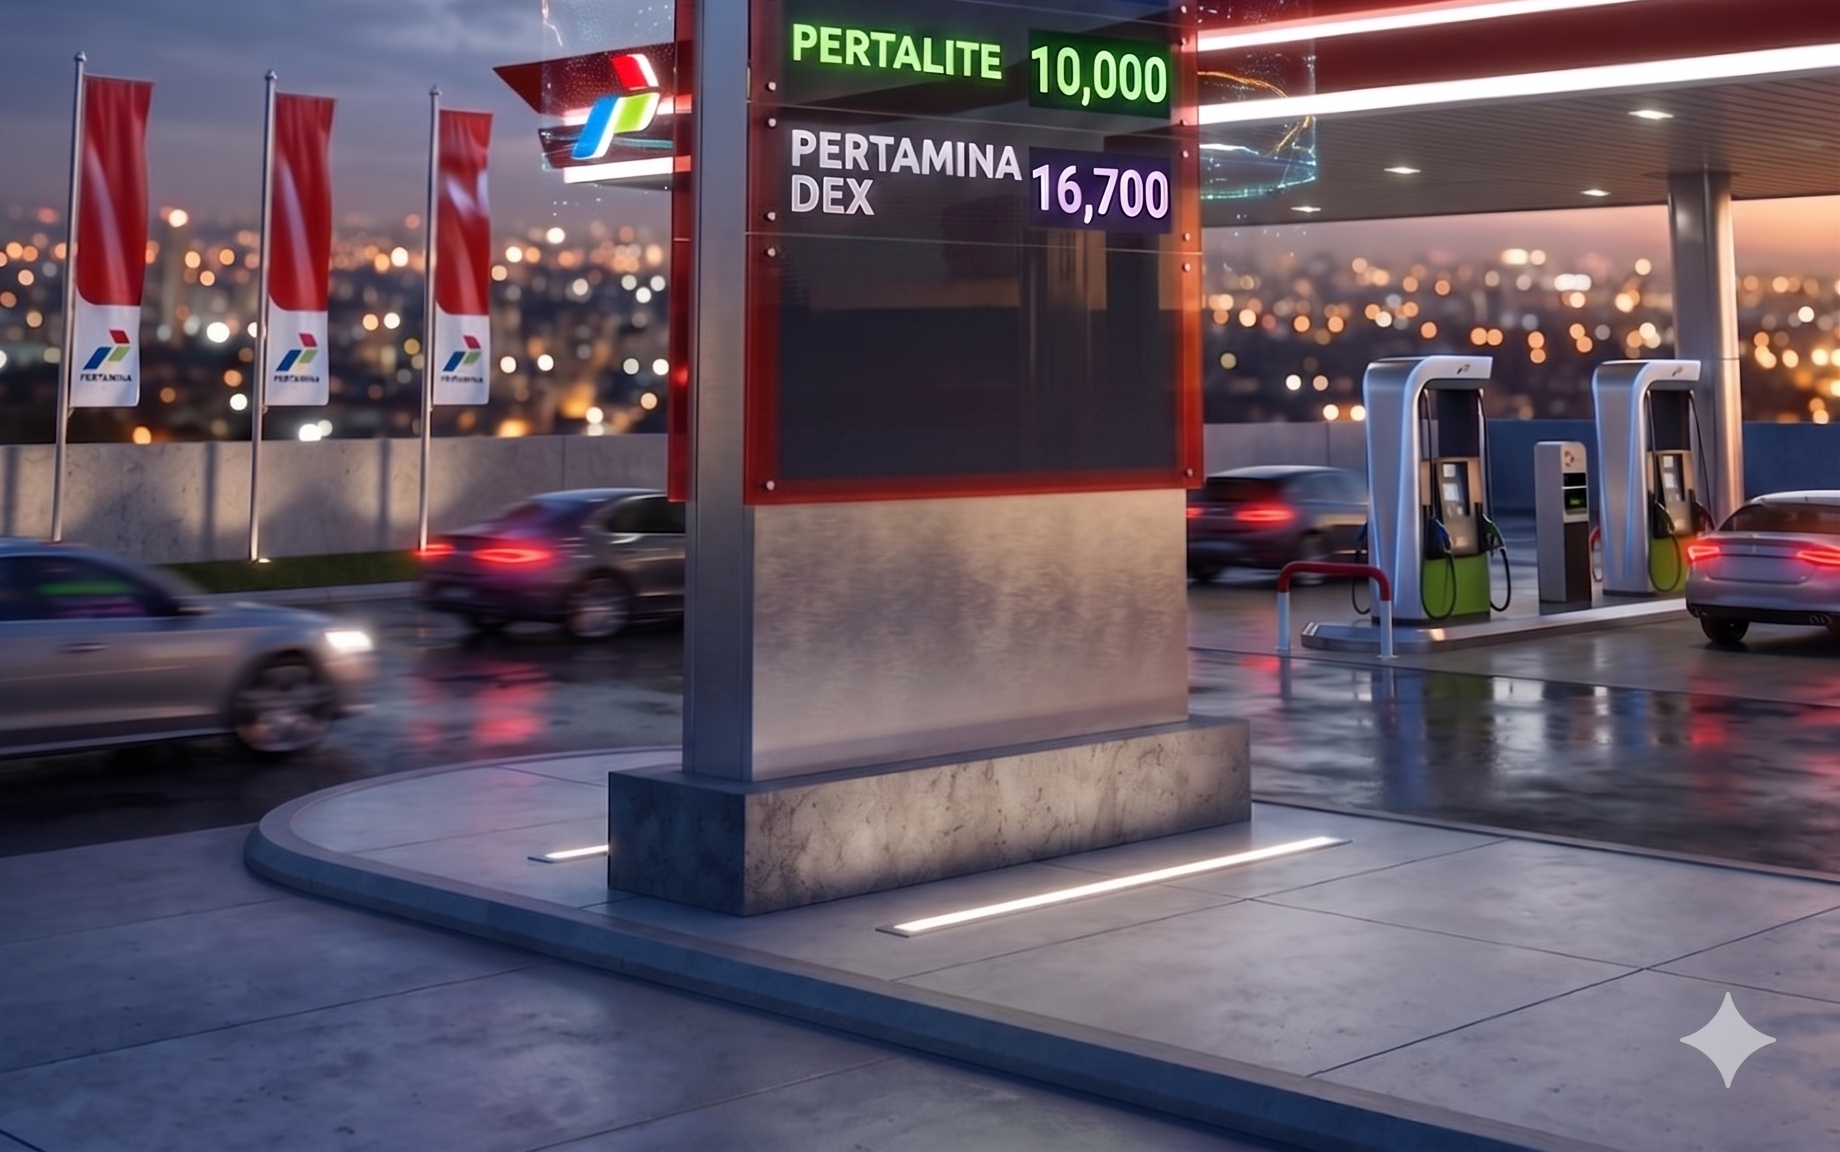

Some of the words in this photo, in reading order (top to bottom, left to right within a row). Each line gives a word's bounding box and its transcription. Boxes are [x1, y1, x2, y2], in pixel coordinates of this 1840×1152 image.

[792, 23, 1003, 80] PERTALITE
[1031, 45, 1168, 107] 10,000
[791, 129, 1022, 181] PERTAMINA
[791, 174, 875, 216] DEX
[1032, 164, 1169, 224] 16,700
